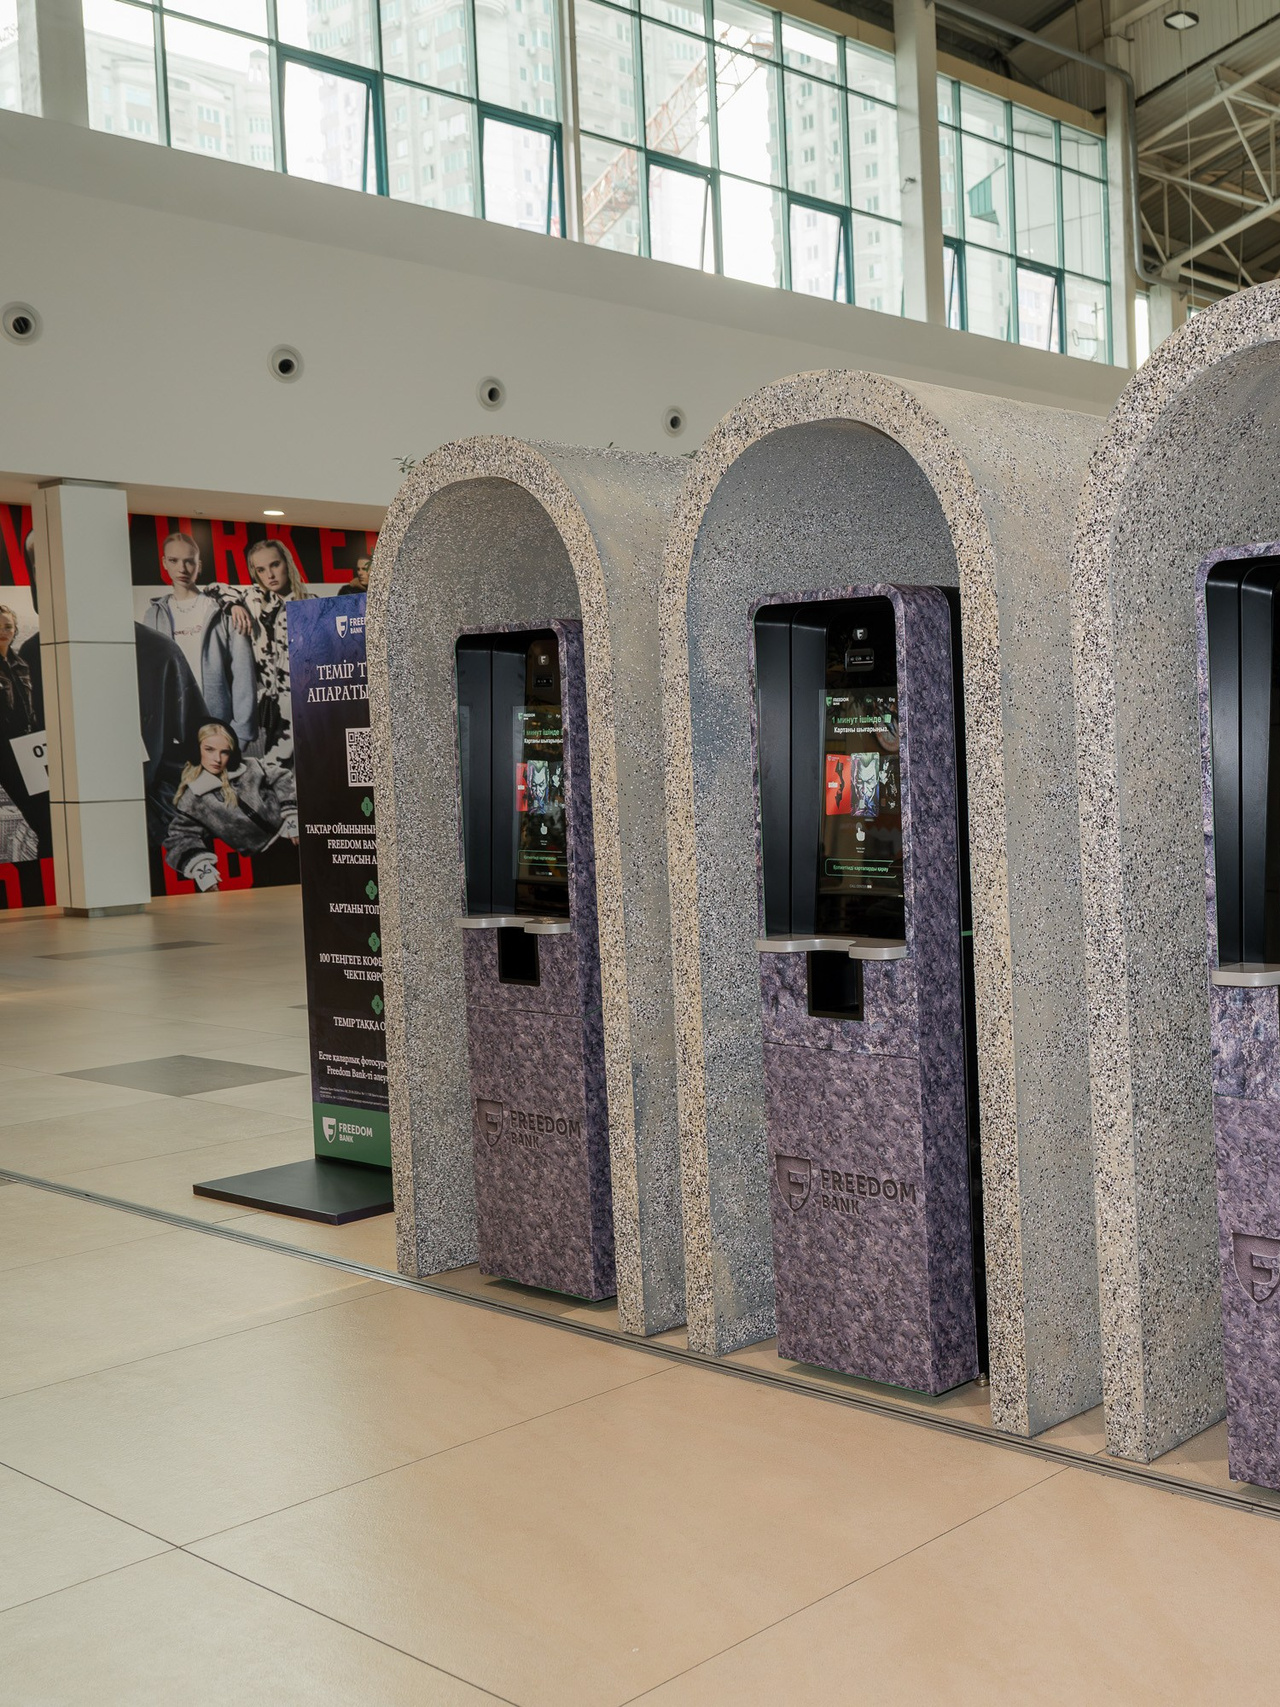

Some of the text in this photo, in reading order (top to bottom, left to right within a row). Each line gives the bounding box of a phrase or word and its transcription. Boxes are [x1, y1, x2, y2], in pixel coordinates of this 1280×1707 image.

[327, 839, 377, 850] FREEDOM BAN
[332, 854, 371, 865] КАРТАСЫН
[330, 903, 365, 914] КАРТАНЫ
[327, 1065, 352, 1077] Freedom
[339, 1122, 373, 1138] FREEDOM
[510, 1110, 581, 1139] FREEDOM
[339, 1134, 354, 1143] BANK
[511, 1131, 540, 1149] BANK
[820, 1169, 917, 1205] FREEDOM
[821, 1194, 860, 1215] BANK
